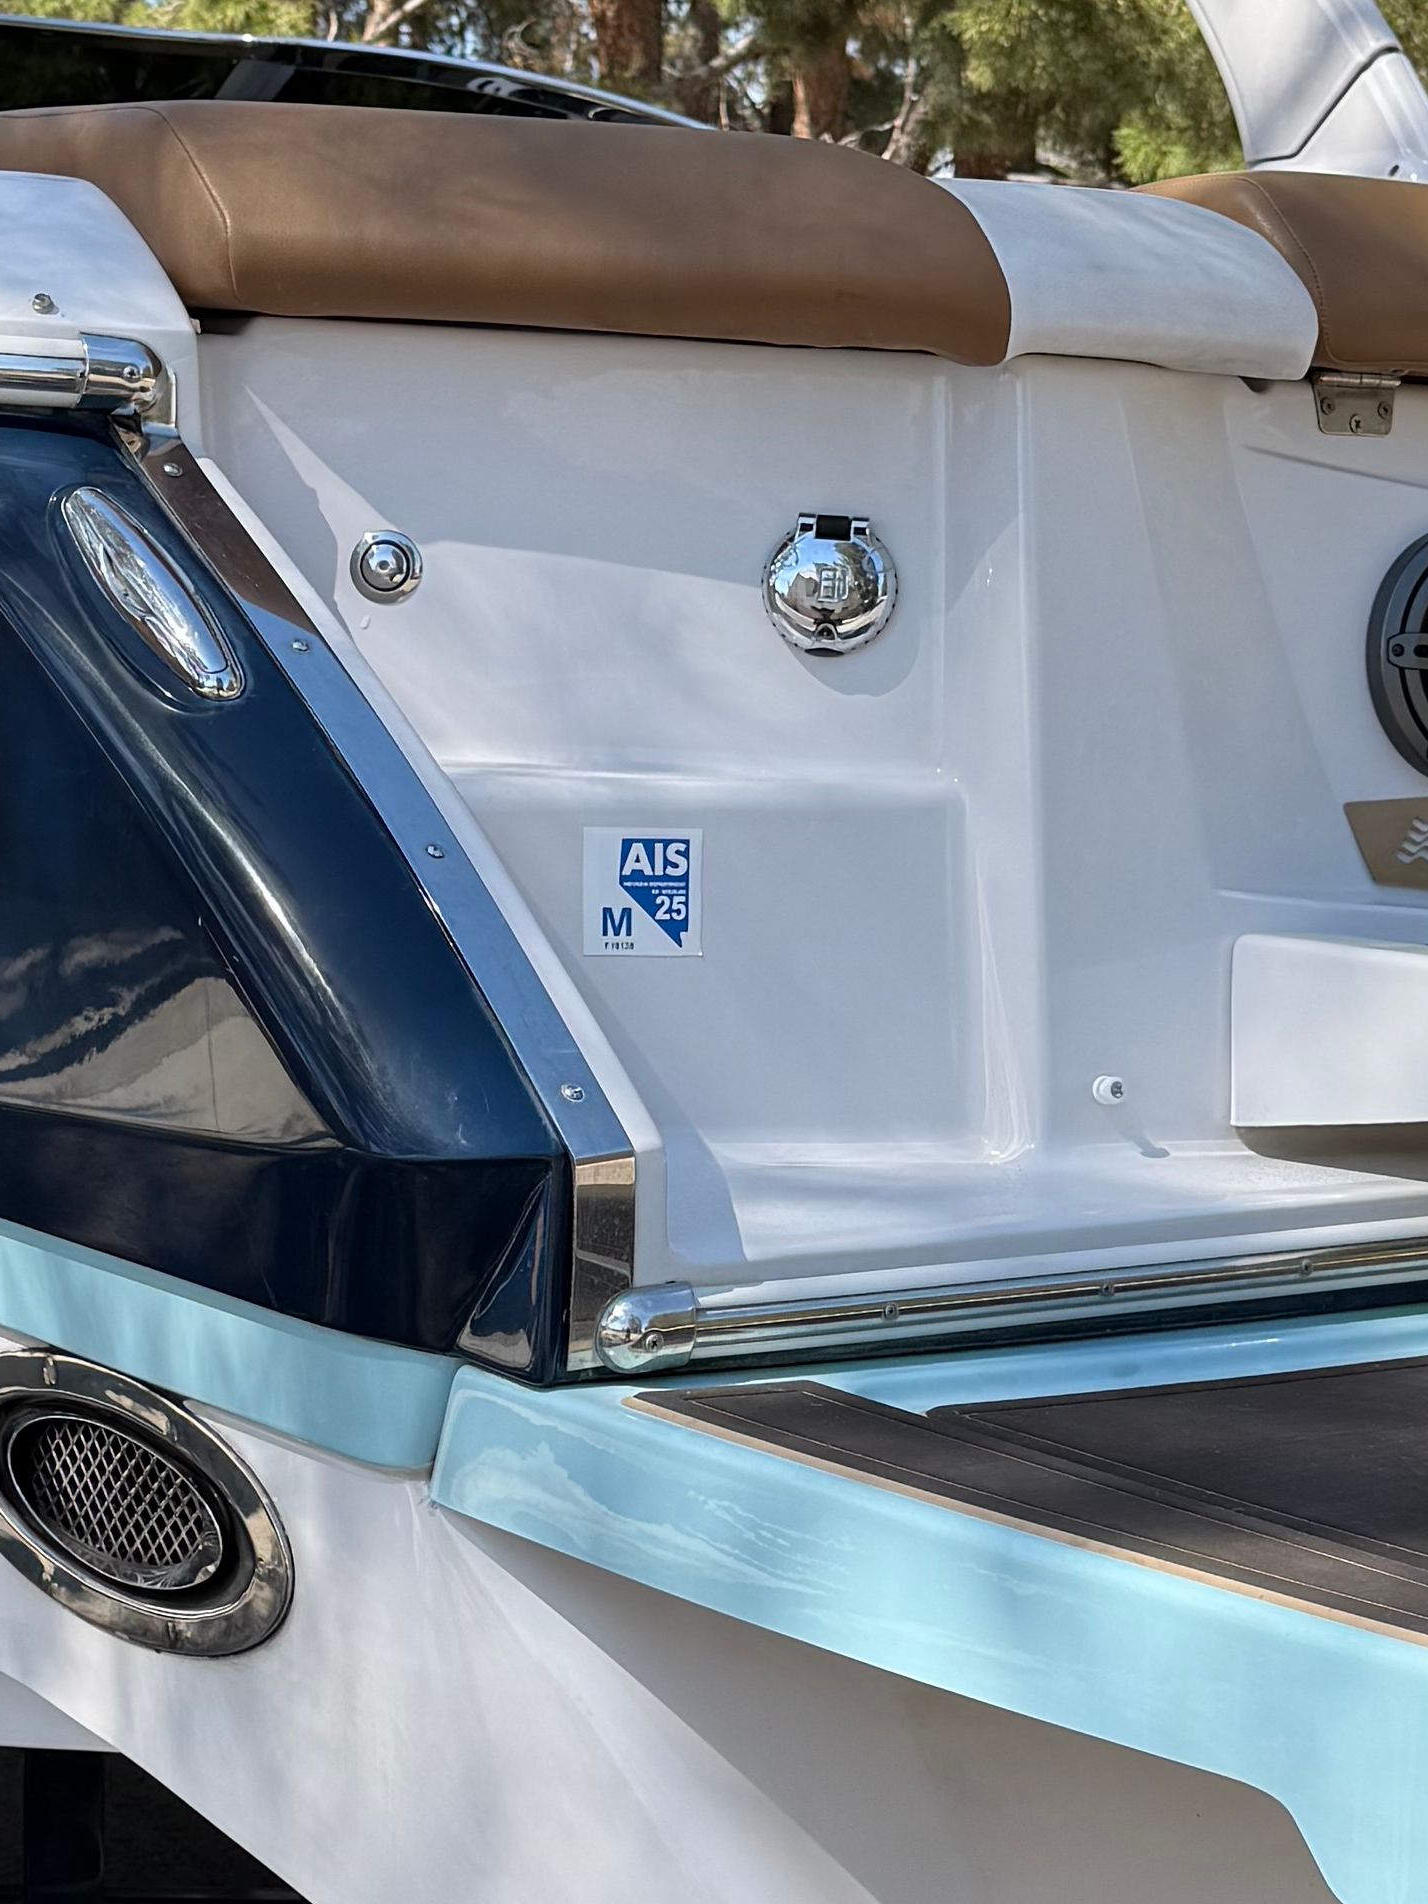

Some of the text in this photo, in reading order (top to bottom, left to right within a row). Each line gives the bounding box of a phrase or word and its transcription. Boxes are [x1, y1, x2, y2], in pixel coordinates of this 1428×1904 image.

[621, 842, 688, 877] AIS
[602, 906, 632, 937] M
[654, 895, 687, 921] 25
